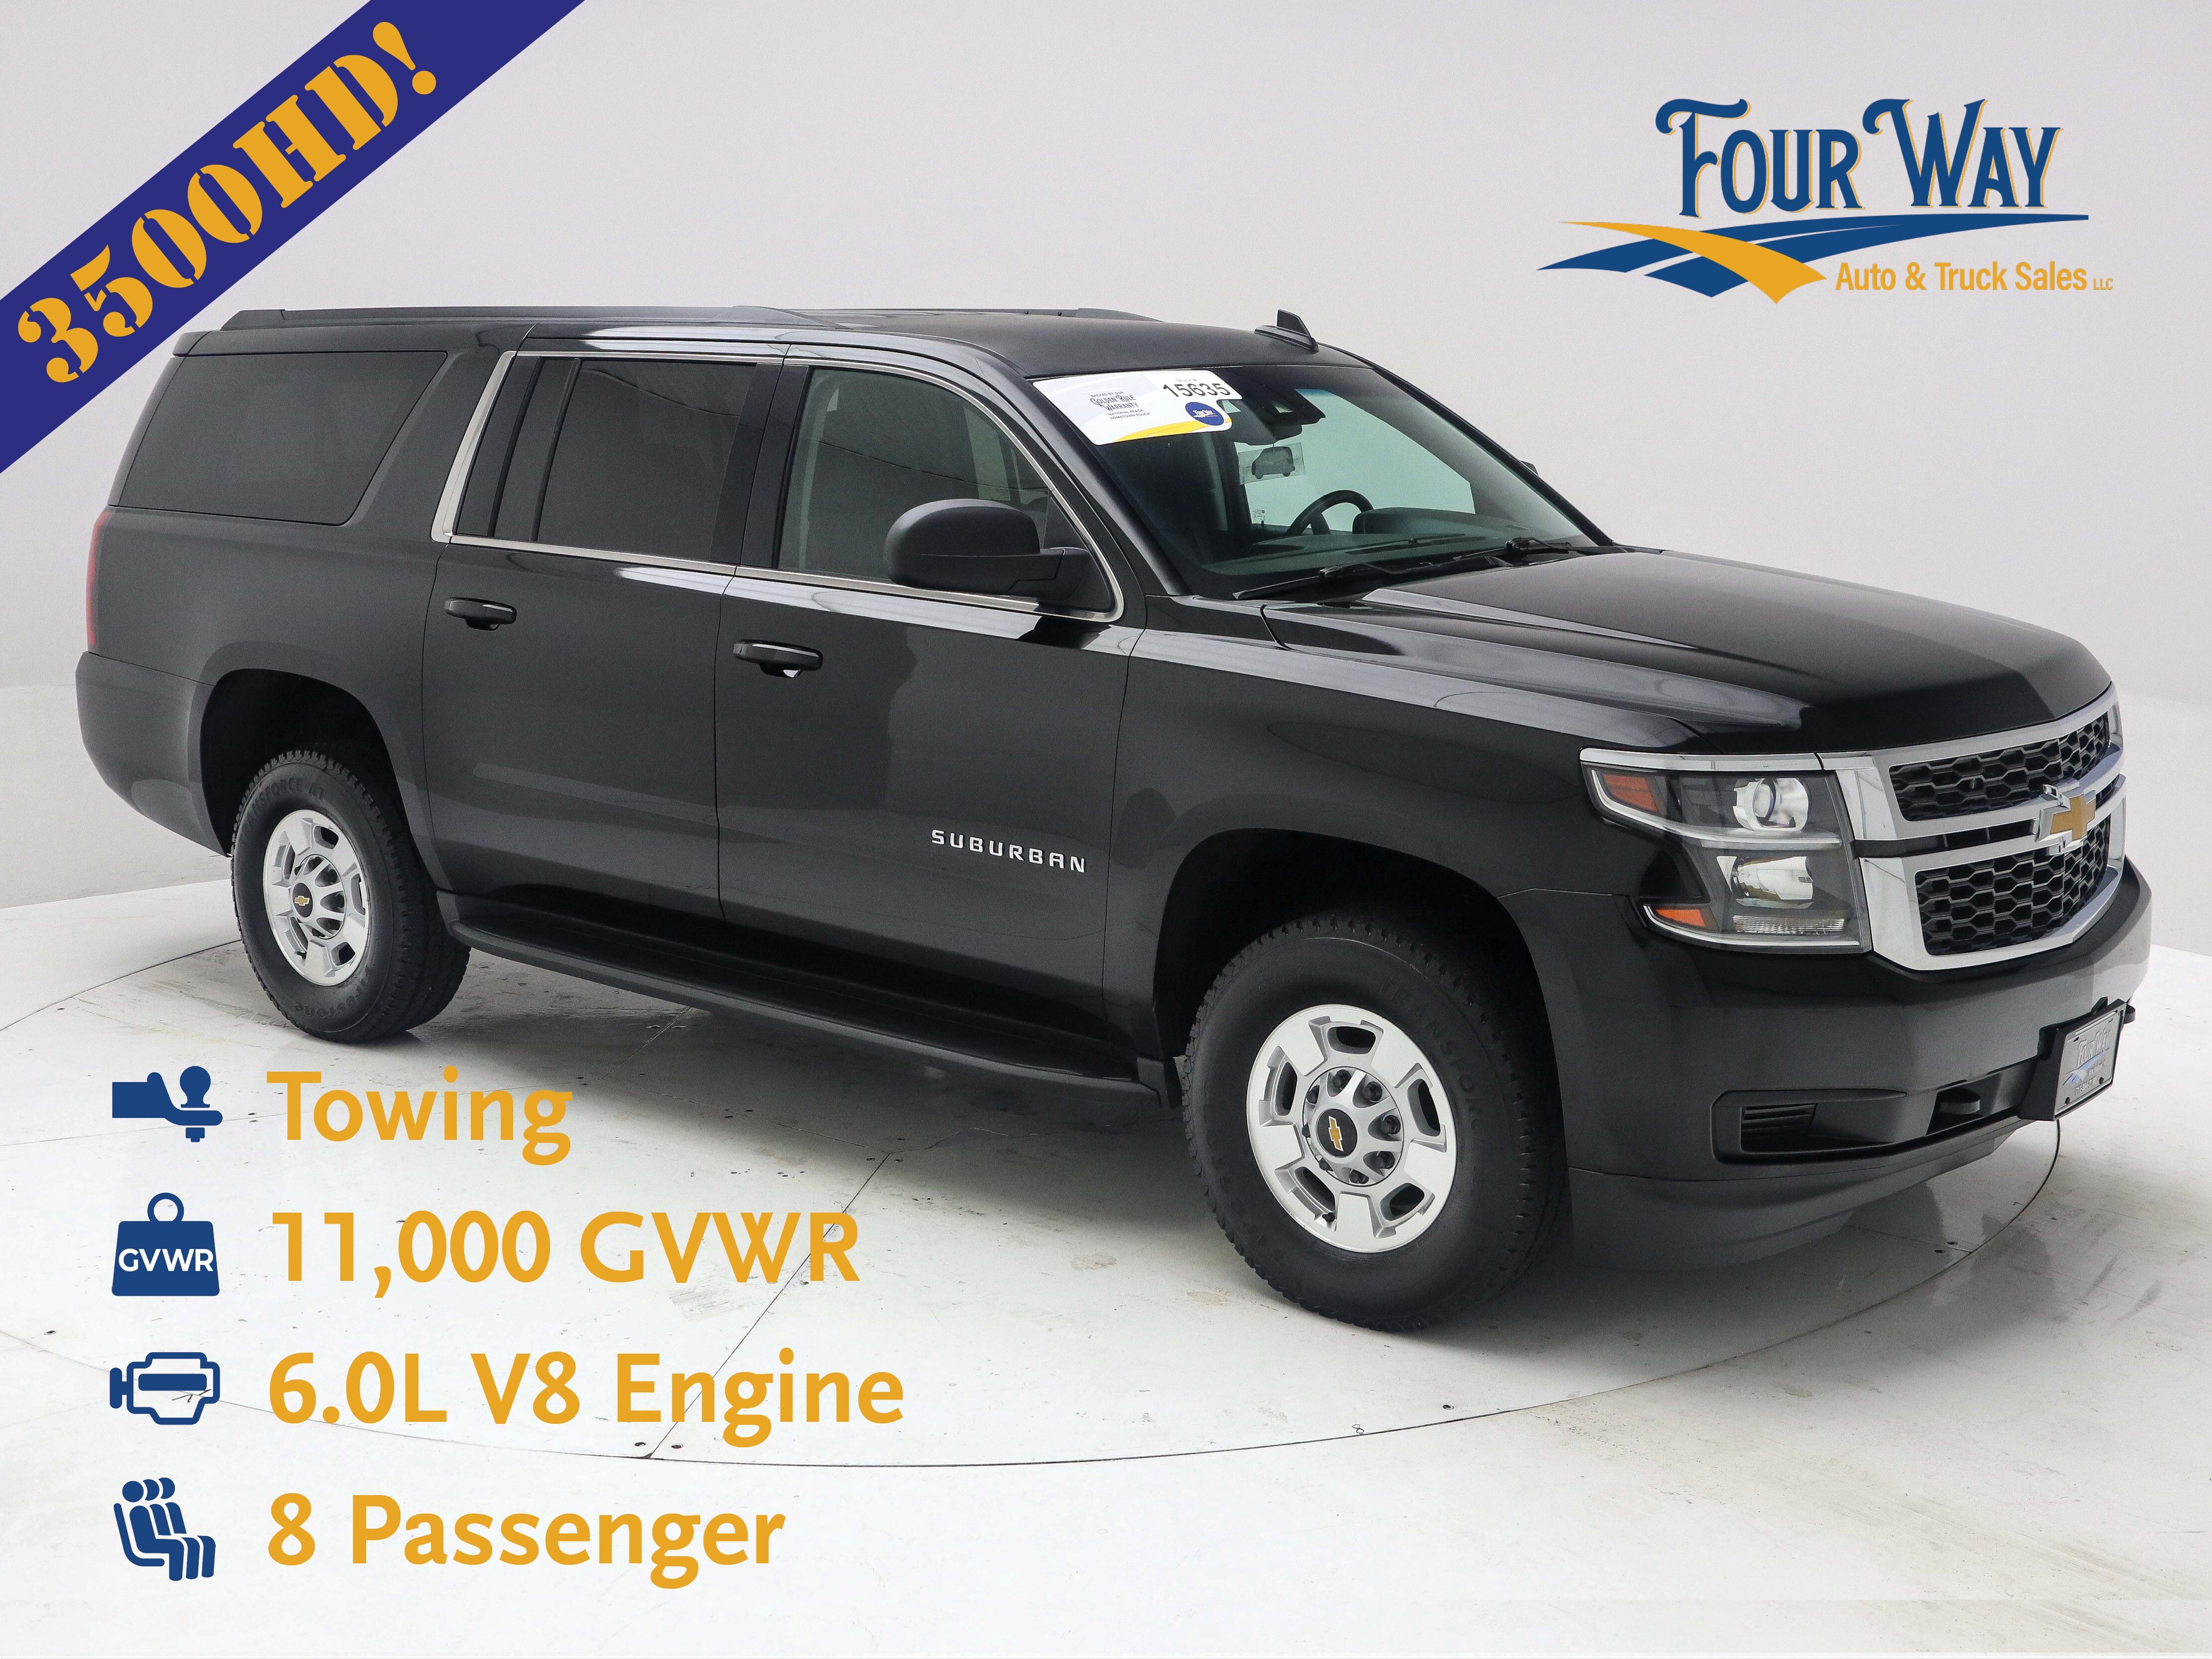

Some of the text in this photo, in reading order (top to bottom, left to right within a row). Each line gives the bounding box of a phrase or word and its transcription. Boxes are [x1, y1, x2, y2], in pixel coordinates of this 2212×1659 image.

[1163, 383, 1231, 397] 15635
[1090, 397, 1118, 406] GOLDEN
[1102, 402, 1139, 412] WARRANTY
[931, 829, 1085, 873] SUBURBAN
